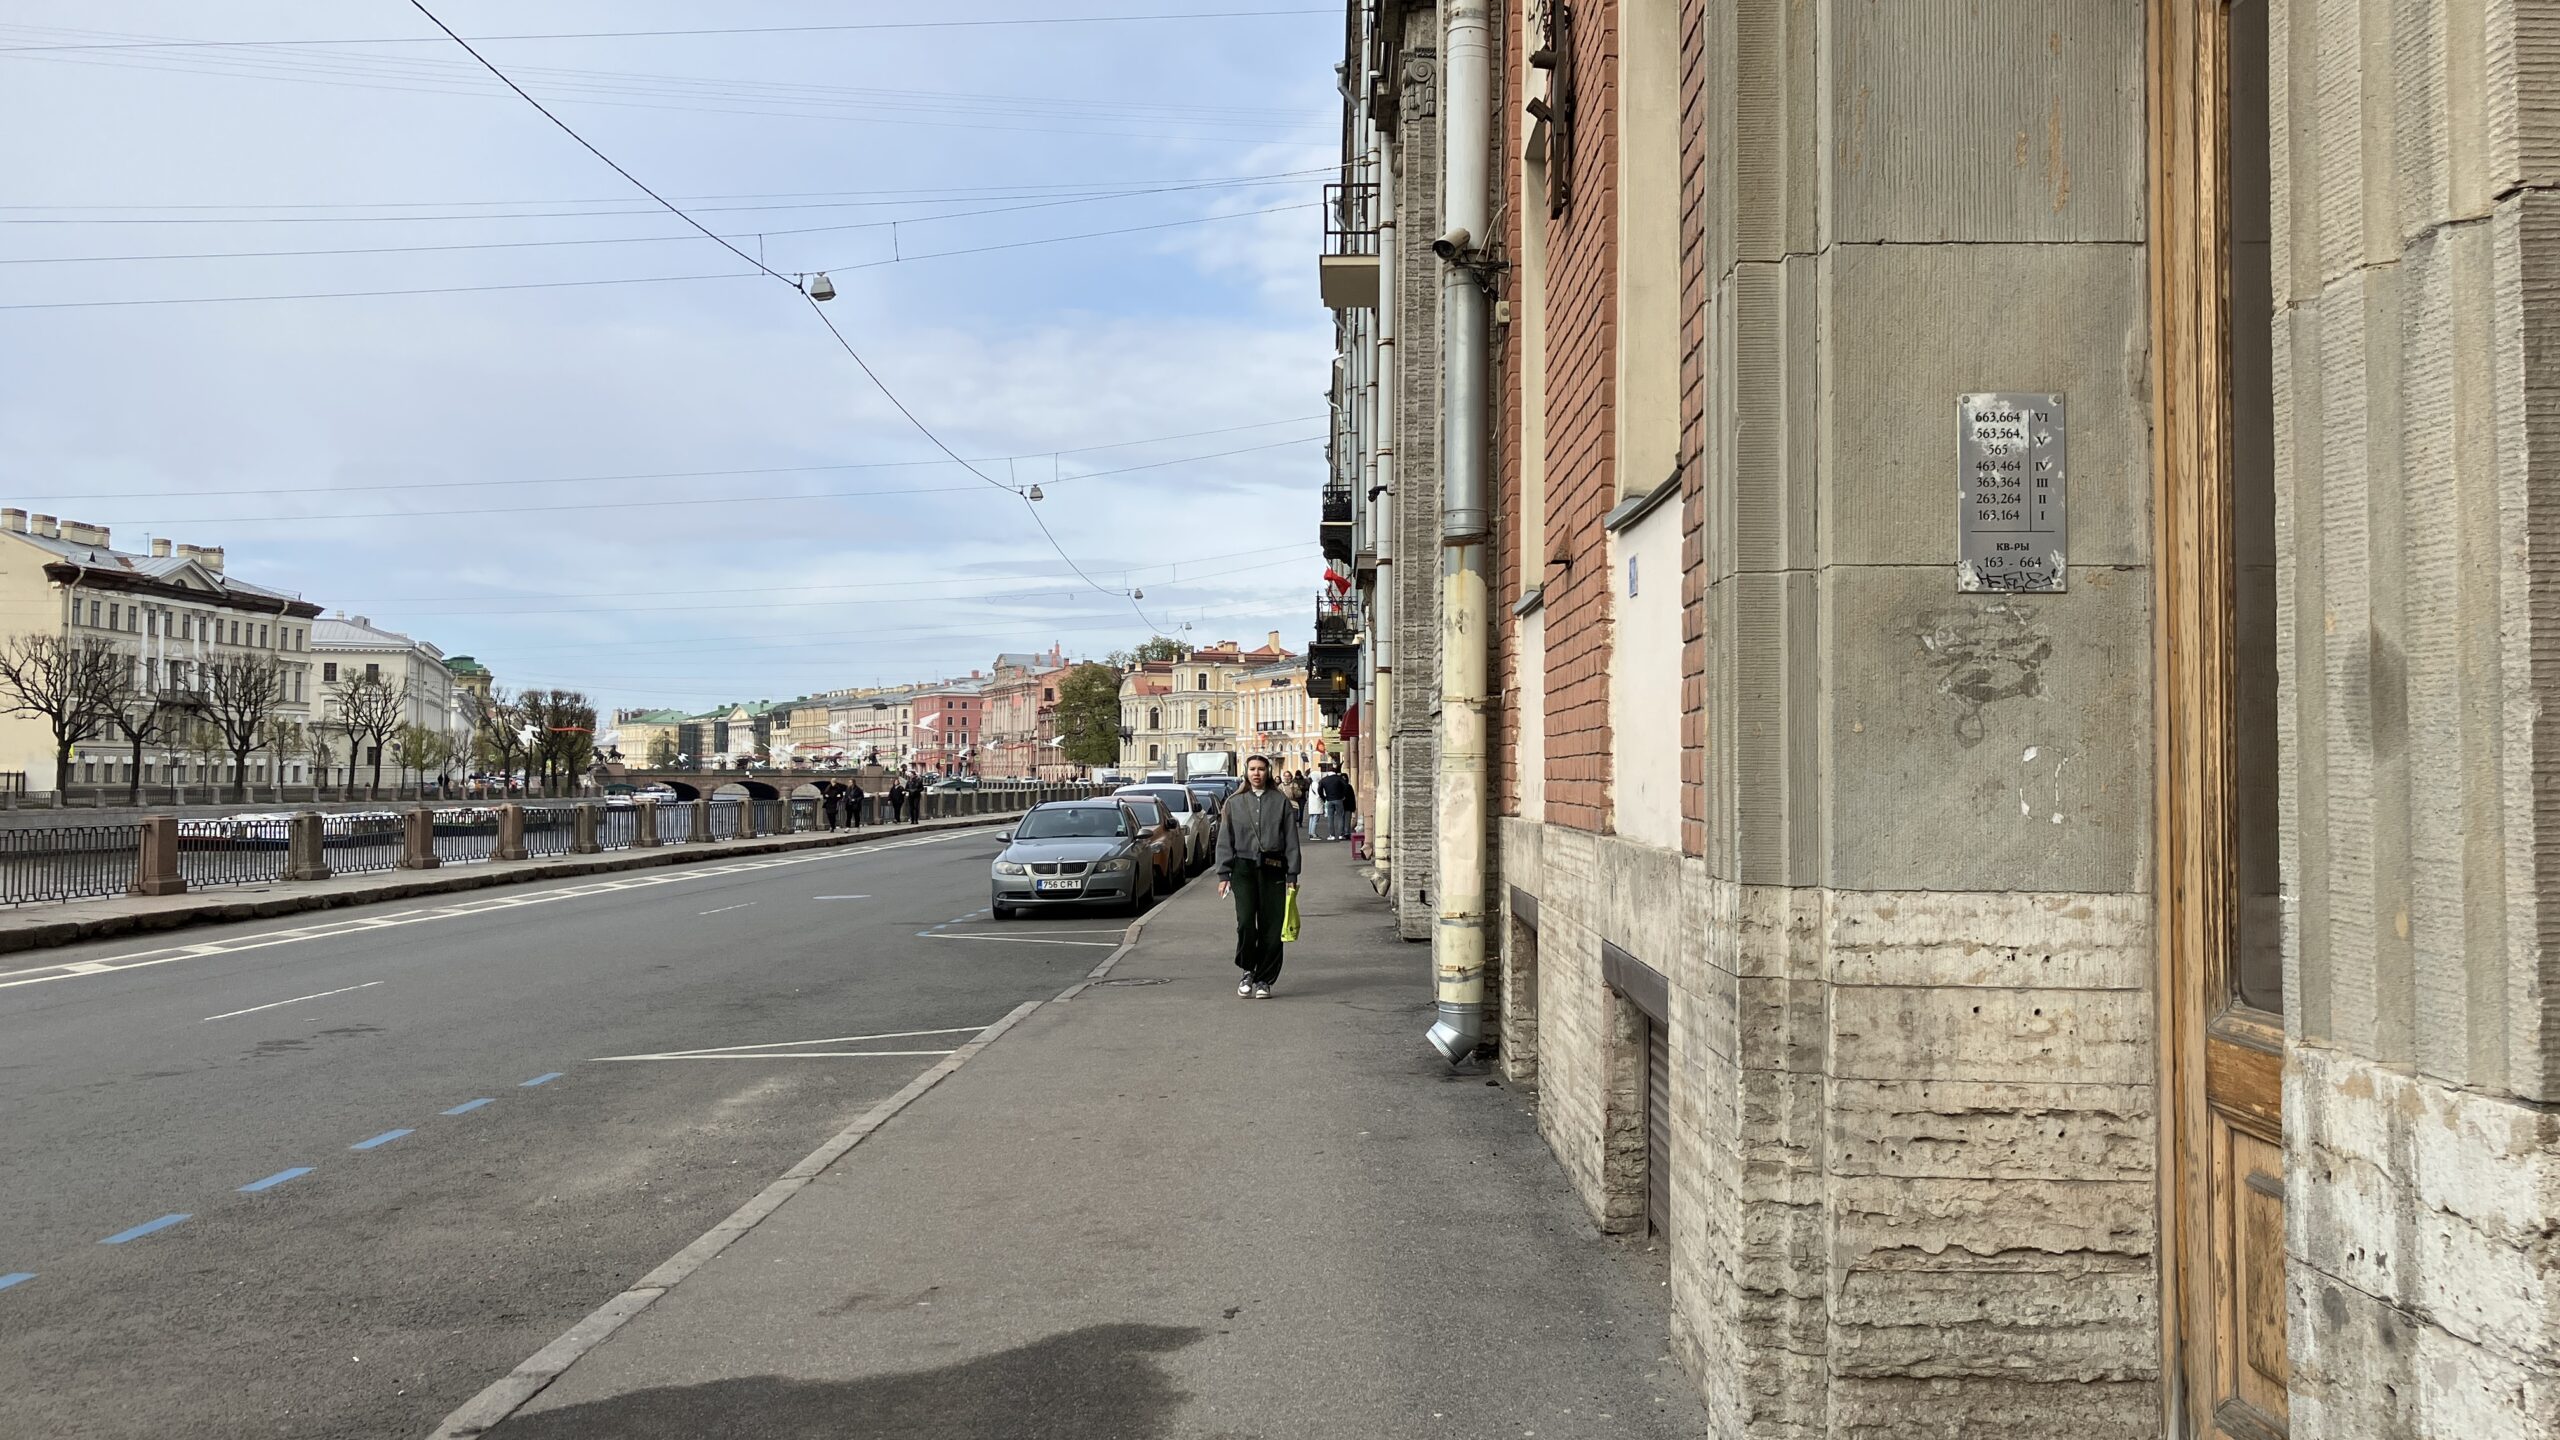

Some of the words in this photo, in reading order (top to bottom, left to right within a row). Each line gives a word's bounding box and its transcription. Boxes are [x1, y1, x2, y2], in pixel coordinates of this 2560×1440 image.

[1975, 412, 2021, 423] 663,664
[2035, 413, 2048, 423] VI
[1976, 428, 2023, 440] 563,564,
[2037, 436, 2047, 445] V
[1988, 445, 2008, 455] 565
[1976, 461, 2021, 472] 463,464
[2035, 462, 2049, 471] IV
[1976, 477, 2021, 488] 363,364
[2036, 478, 2048, 488] III
[1976, 493, 2021, 505] 263,264
[2038, 495, 2047, 504] II
[1979, 510, 2020, 521] 163,164
[1984, 557, 2003, 567] 163
[2020, 557, 2042, 567] 664
